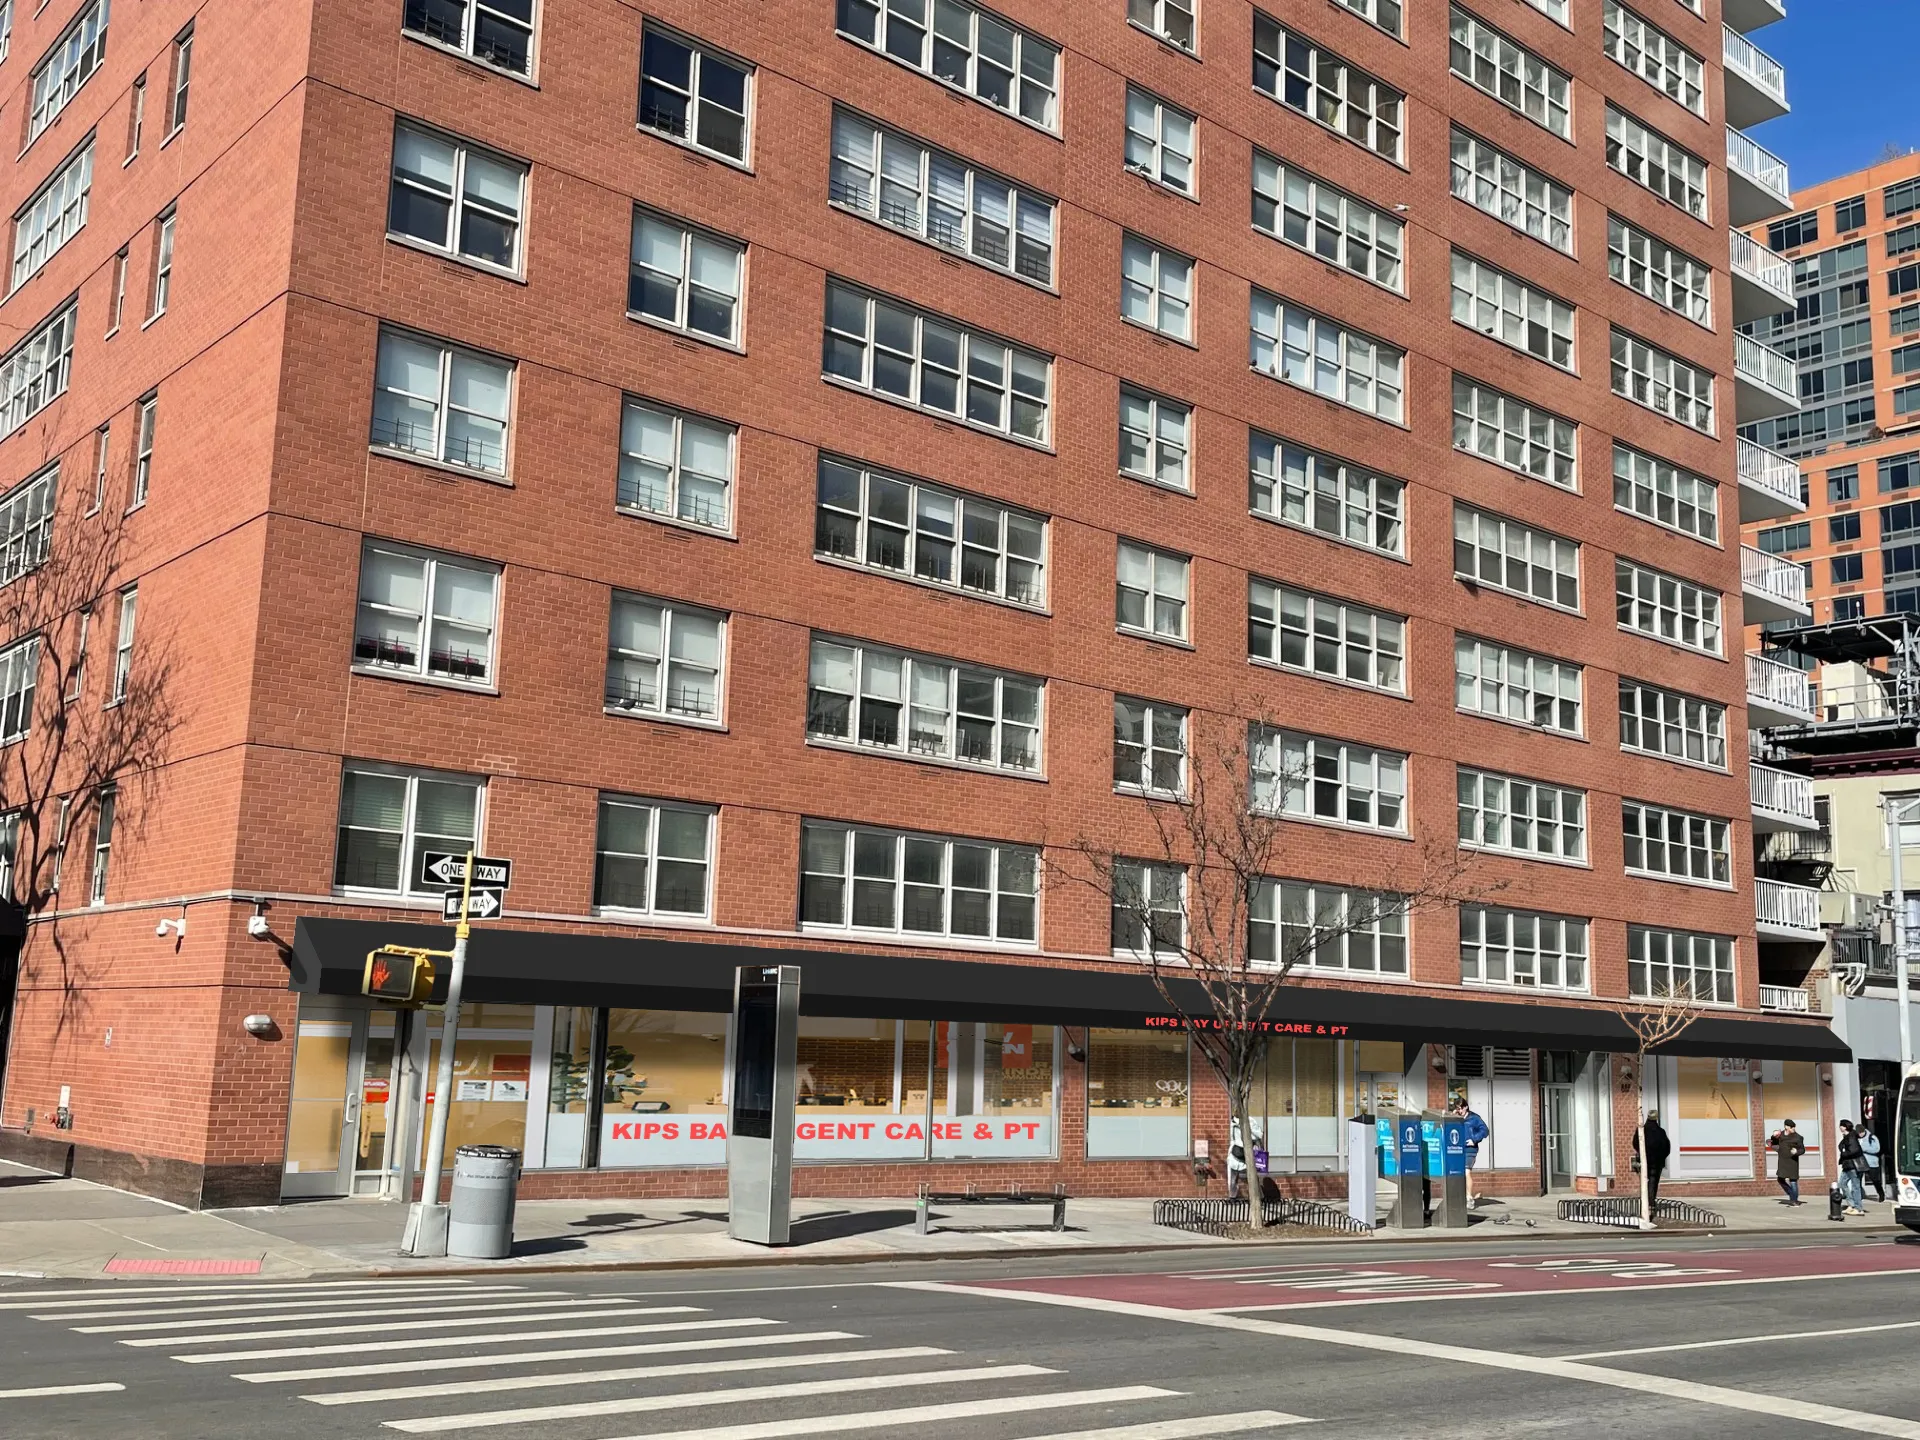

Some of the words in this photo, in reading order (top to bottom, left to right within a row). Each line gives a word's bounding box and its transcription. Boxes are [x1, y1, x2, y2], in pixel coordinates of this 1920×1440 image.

[441, 863, 464, 877] ONE
[476, 867, 502, 879] WAY
[451, 898, 464, 911] ON
[472, 898, 492, 910] WAY
[1145, 1017, 1178, 1027] KIPS
[1274, 1023, 1313, 1033] CARE
[1316, 1025, 1327, 1034] &
[1331, 1026, 1349, 1035] PT
[612, 1123, 679, 1140] KIPS
[689, 1123, 727, 1140] BA
[795, 1123, 876, 1140] GENT
[885, 1123, 962, 1140] CARE
[973, 1123, 993, 1140] &
[1004, 1123, 1040, 1140] PT
